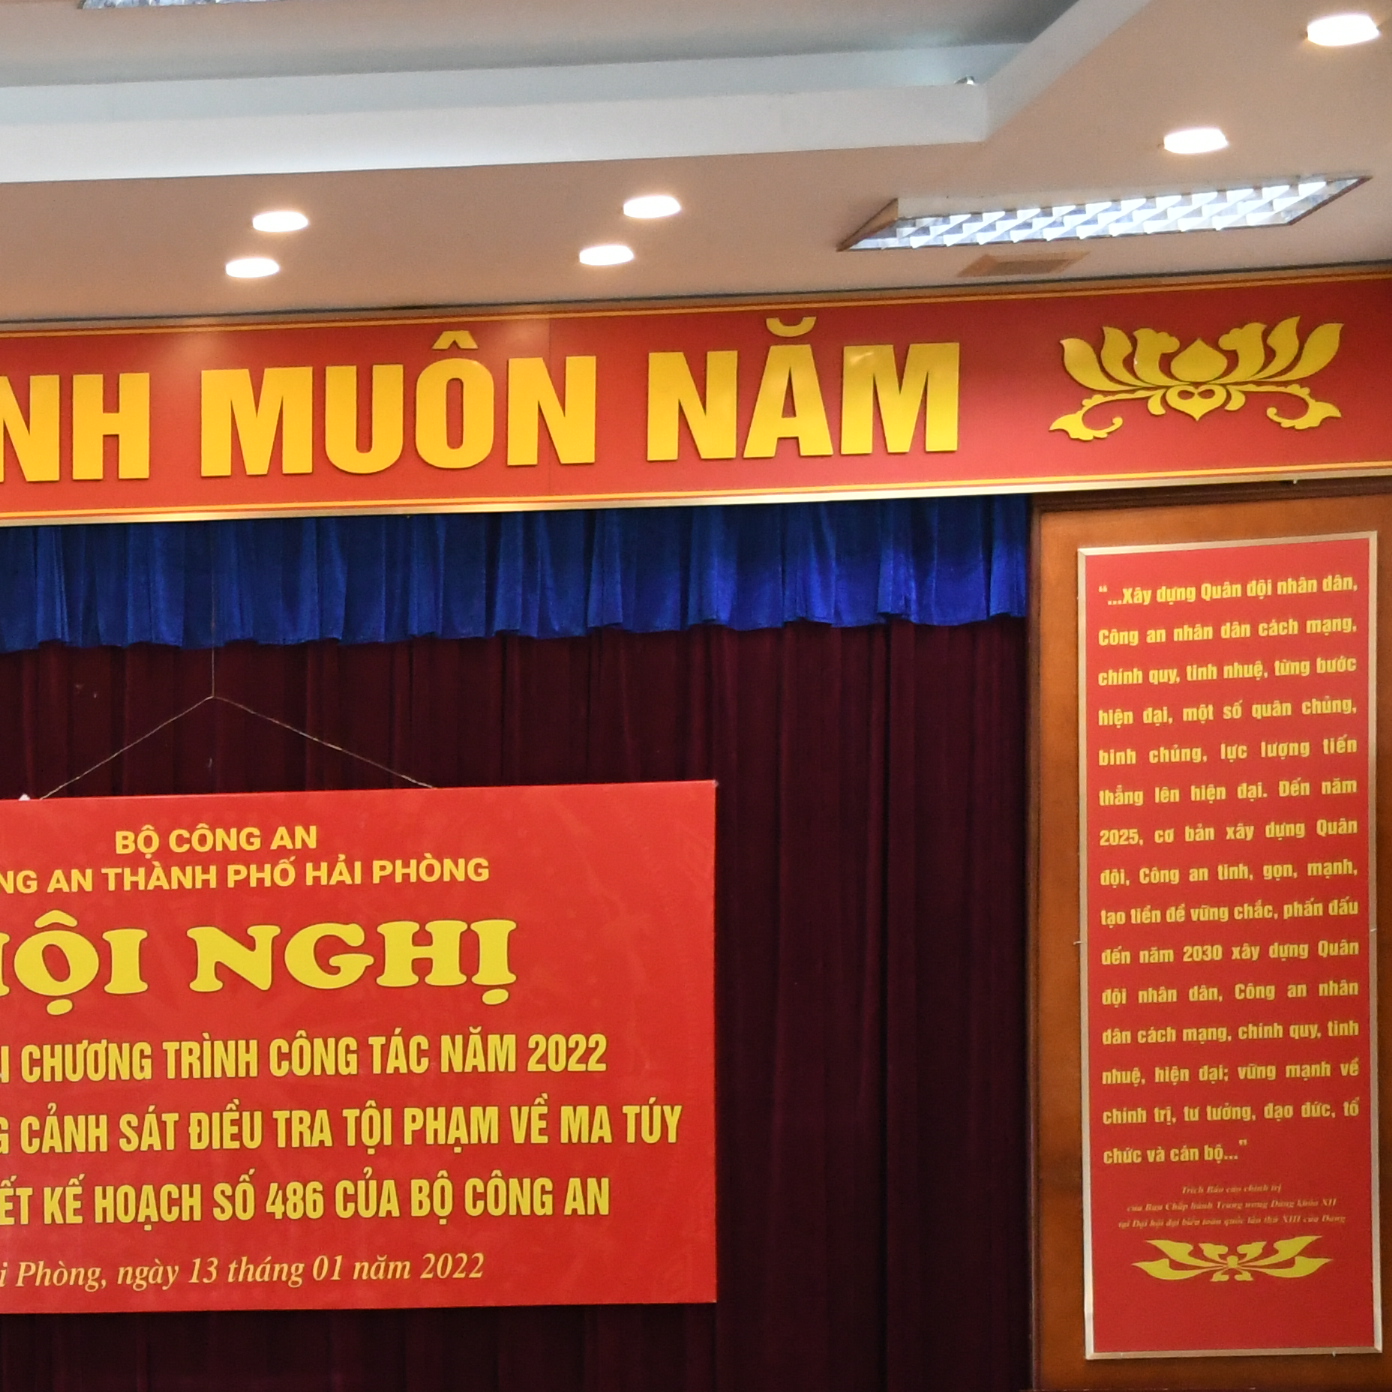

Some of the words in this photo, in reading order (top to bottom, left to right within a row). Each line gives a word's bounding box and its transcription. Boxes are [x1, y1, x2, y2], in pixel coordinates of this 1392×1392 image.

[199, 329, 598, 477] MUÔN
[644, 316, 962, 462] NĂM
[1156, 585, 1197, 605] dựng
[1200, 581, 1242, 602] Quân
[1246, 579, 1273, 600] đội
[1277, 576, 1318, 595] nhân
[1322, 574, 1358, 592] dân,
[1098, 628, 1140, 647] Công
[1146, 628, 1167, 644] an
[1173, 623, 1214, 642] nhân
[1220, 621, 1251, 639] dân
[1258, 618, 1299, 637] cách
[1306, 617, 1357, 636] mạng,
[1154, 786, 1180, 804] lên
[1190, 783, 1227, 804] hiện
[1237, 781, 1268, 802] đại.
[1278, 777, 1311, 797] Đến
[1321, 777, 1358, 795] năm
[115, 824, 160, 860] BỘ
[168, 822, 262, 853] CÔNG
[269, 825, 318, 850] AN
[1099, 828, 1144, 846] 2025,
[1184, 823, 1215, 842] bản
[1225, 822, 1255, 841] xây
[1265, 821, 1306, 841] dựng
[1316, 817, 1358, 837] Quân
[46, 868, 93, 893] AN
[100, 860, 217, 892] THÀNH
[227, 855, 296, 888] PHỐ
[305, 854, 362, 886] HẢI
[372, 853, 490, 884] PHÒNG
[186, 919, 517, 1005] NGHỊ
[1101, 945, 1131, 966] đến
[1139, 946, 1175, 964] năm
[1182, 944, 1223, 962] 2030
[1231, 942, 1260, 961] xây
[1268, 941, 1309, 962] dựng
[1317, 939, 1360, 958] Quân
[1101, 987, 1127, 1009] đội
[1137, 985, 1178, 1004] nhân
[1188, 984, 1223, 1003] dân,
[1234, 982, 1276, 1001] Công
[1287, 983, 1307, 998] an
[1318, 979, 1359, 997] nhân
[20, 1038, 153, 1083] CHƯƠNG
[162, 1032, 258, 1080] TRÌNH
[269, 1029, 358, 1077] CÔNG
[367, 1027, 429, 1075] TÁC
[440, 1026, 517, 1073] NĂM
[527, 1033, 607, 1073] 2022
[20, 1102, 108, 1155] CẢNH
[118, 1104, 180, 1152] SÁT
[188, 1098, 263, 1150] ĐIỀU
[272, 1109, 333, 1148] TRA
[342, 1099, 392, 1155] TỘI
[403, 1106, 499, 1154] PHẠM
[509, 1092, 549, 1144] VỀ
[560, 1105, 613, 1144] MA
[622, 1096, 683, 1144] TÚY
[43, 1173, 86, 1225] KẾ
[94, 1183, 202, 1231] HOẠCH
[212, 1168, 256, 1222] SỐ
[265, 1180, 325, 1220] 486
[335, 1166, 401, 1219] CỦA
[410, 1169, 453, 1225] BỘ
[464, 1169, 554, 1217] CÔNG
[563, 1177, 610, 1216] AN
[15, 1260, 107, 1293] Phòng,
[117, 1258, 180, 1292] ngày
[188, 1256, 219, 1284] 13
[227, 1255, 305, 1288] tháng
[312, 1254, 343, 1281] 01
[352, 1254, 411, 1280] năm
[419, 1252, 485, 1279] 2022
